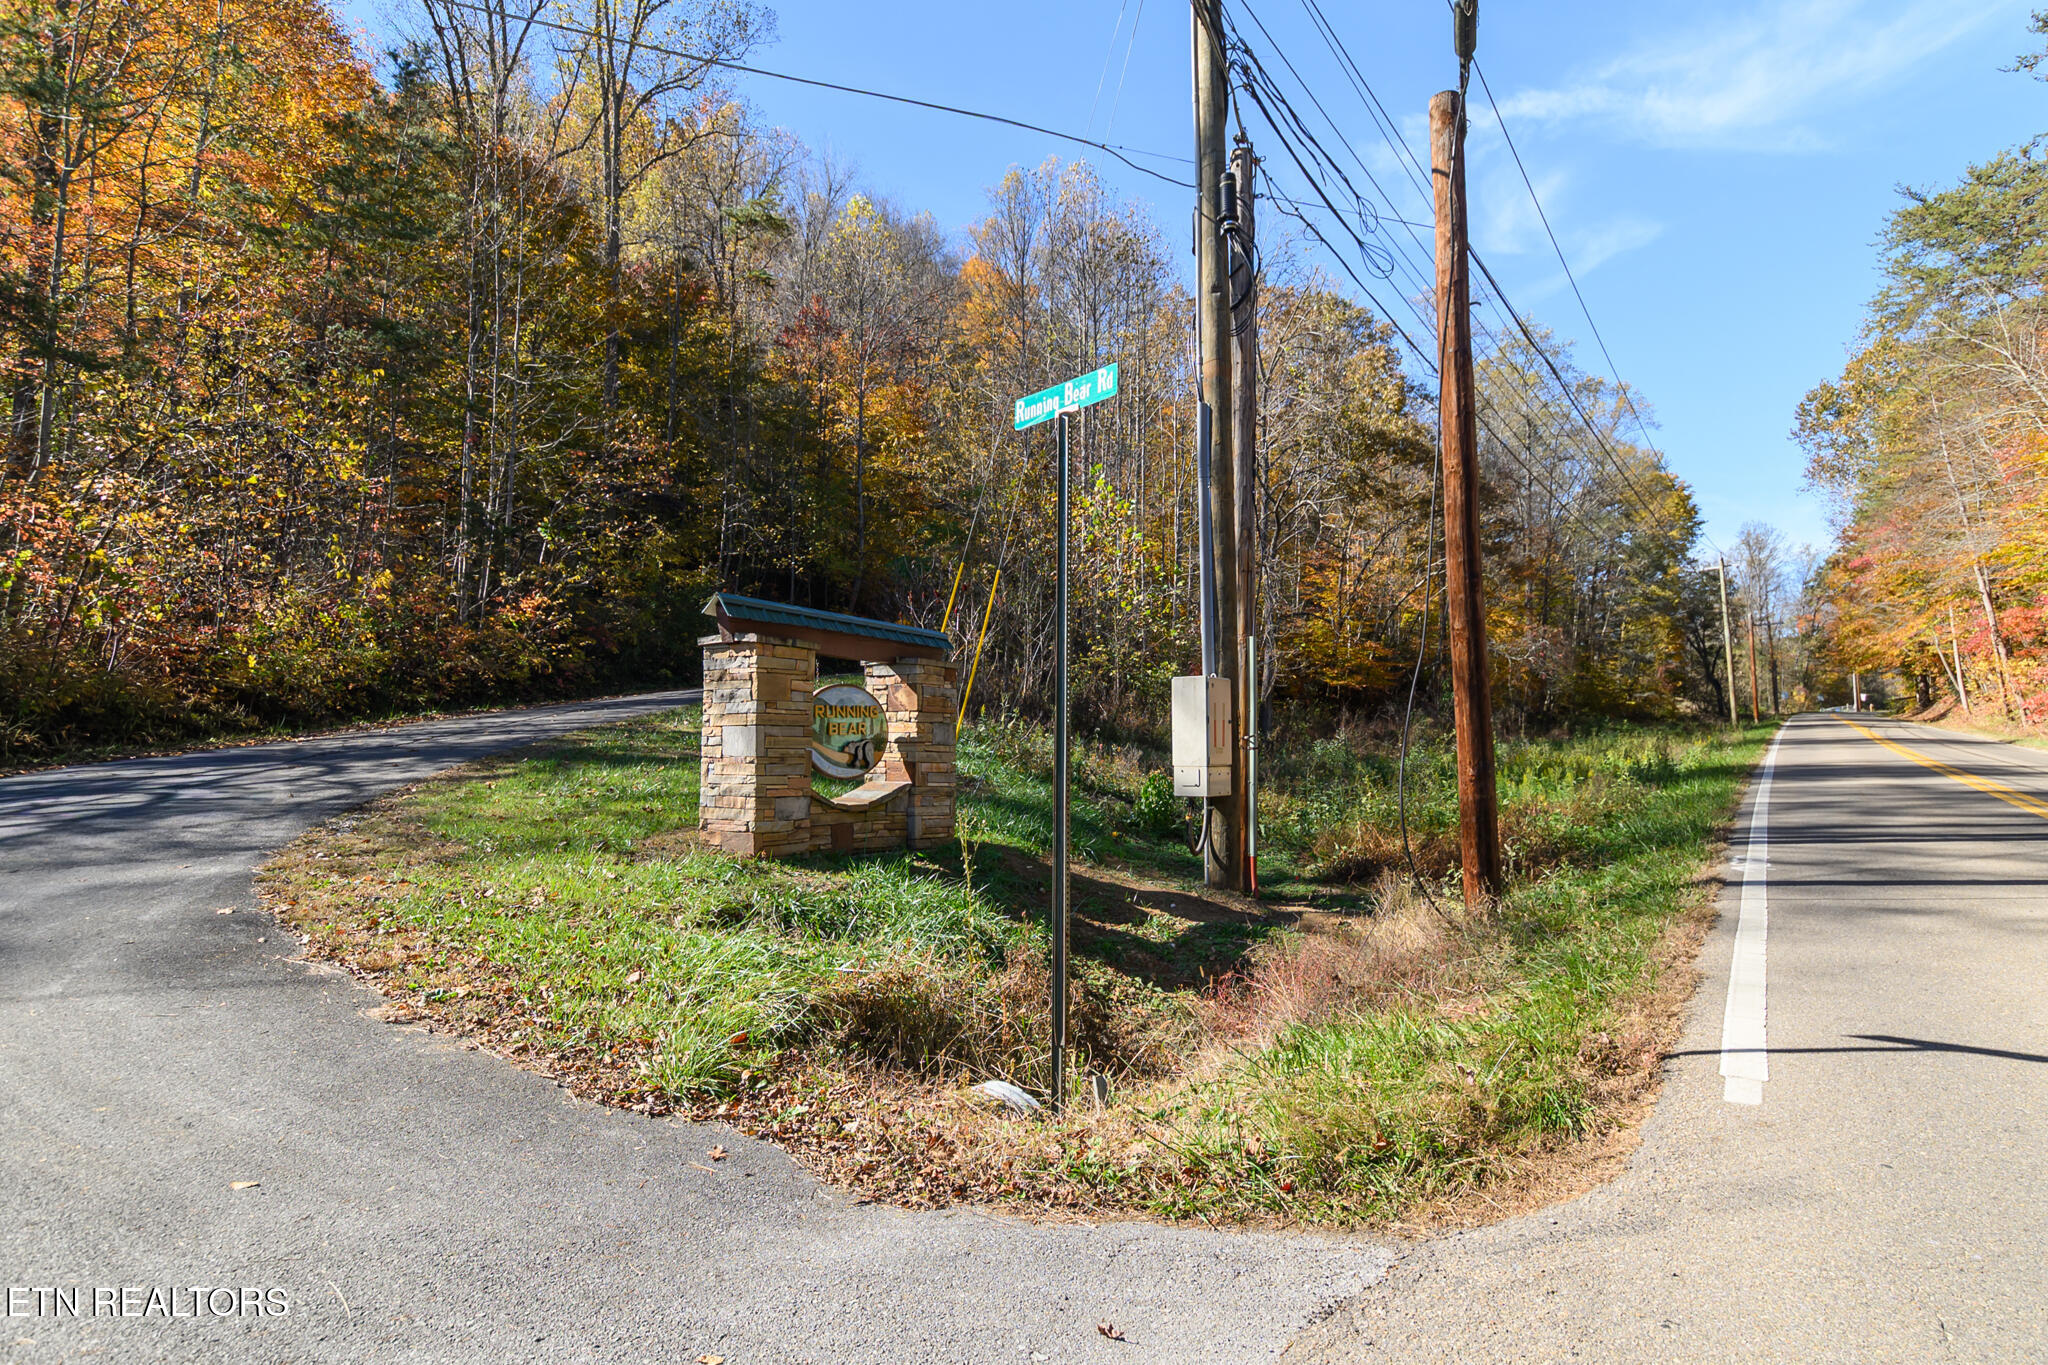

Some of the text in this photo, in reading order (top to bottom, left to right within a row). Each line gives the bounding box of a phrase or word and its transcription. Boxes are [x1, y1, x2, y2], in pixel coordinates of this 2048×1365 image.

[1015, 368, 1114, 424] Running Bear Rd
[814, 704, 880, 719] RUNNING
[828, 721, 867, 737] BEAR
